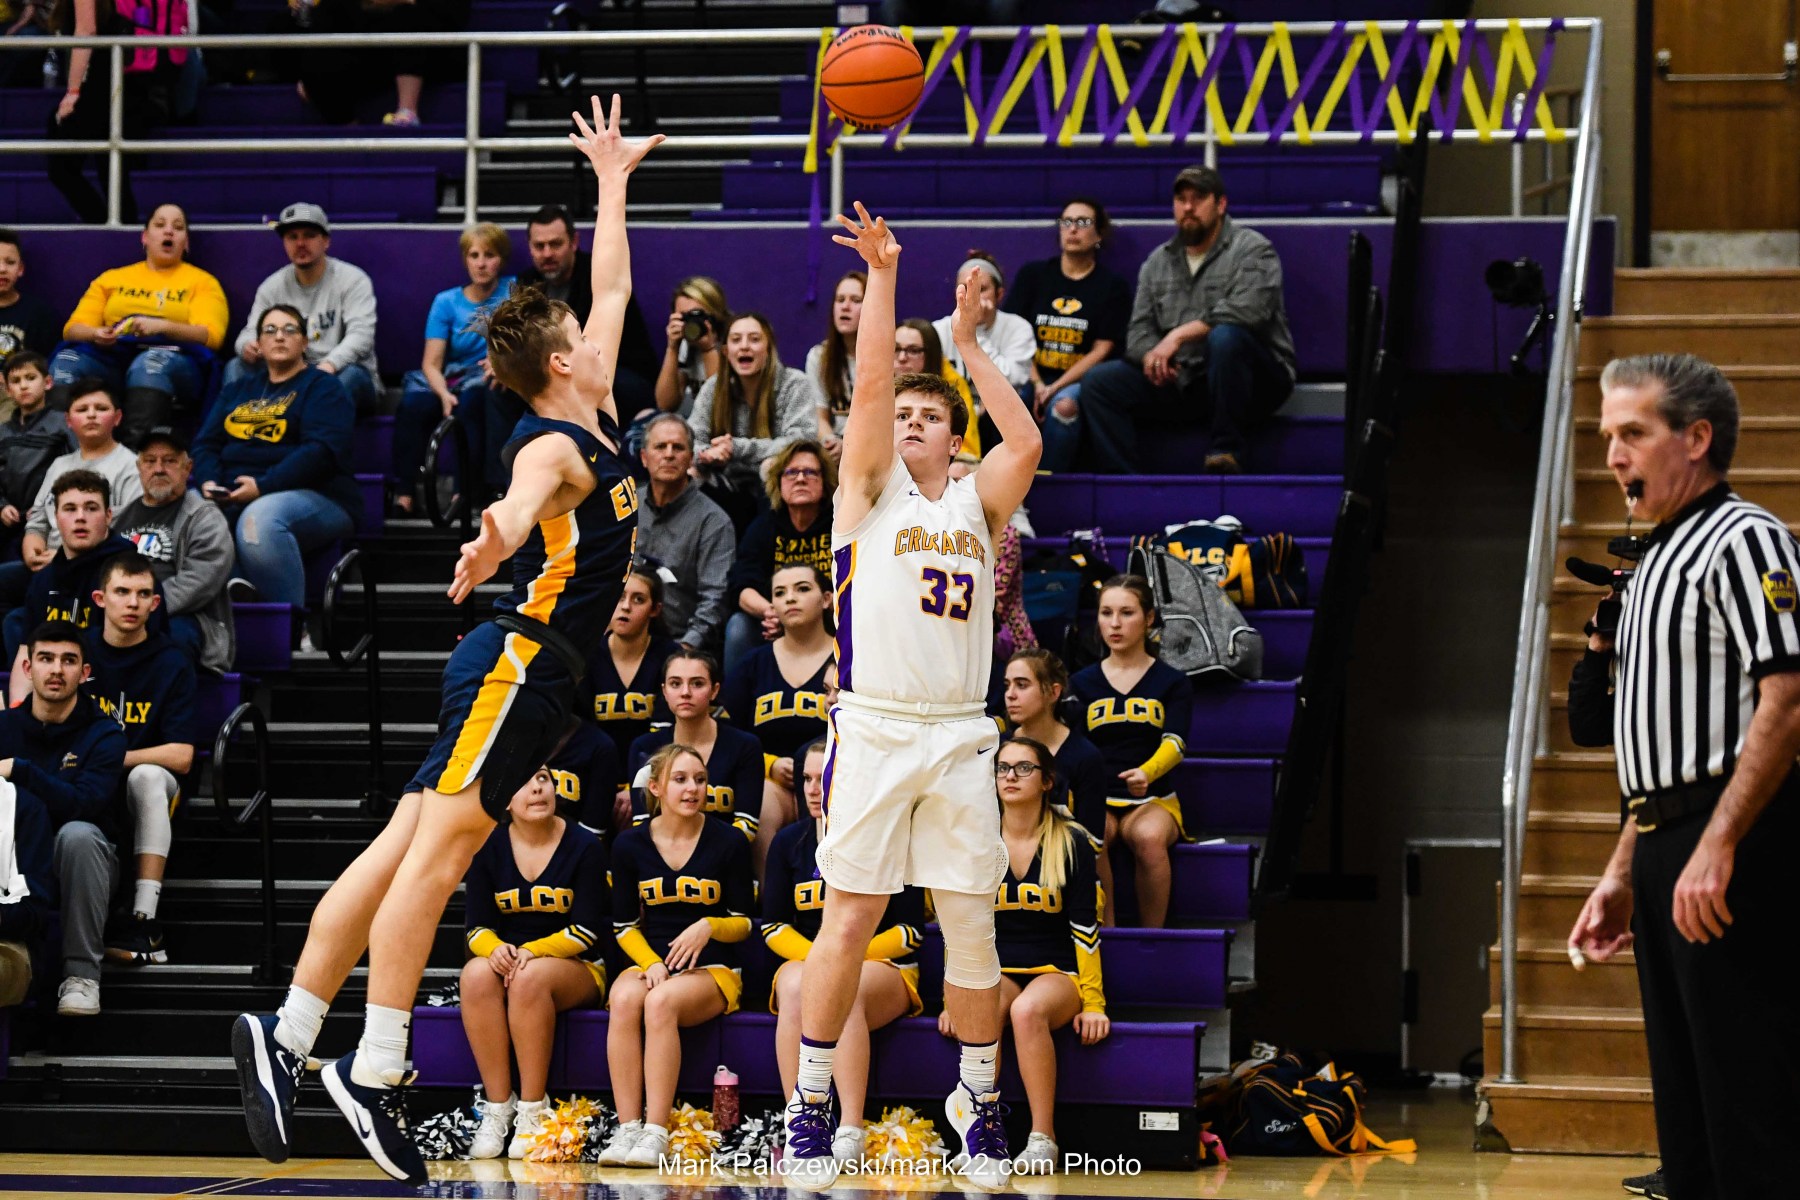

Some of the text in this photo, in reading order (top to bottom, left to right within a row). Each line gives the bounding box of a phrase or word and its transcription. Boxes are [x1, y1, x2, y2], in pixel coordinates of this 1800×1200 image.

[920, 565, 975, 622] 33
[1087, 696, 1165, 731] ELCO
[494, 885, 575, 914] ELCO
[638, 875, 722, 906] ELCO
[794, 879, 825, 912] EL
[993, 882, 1063, 914] LCO
